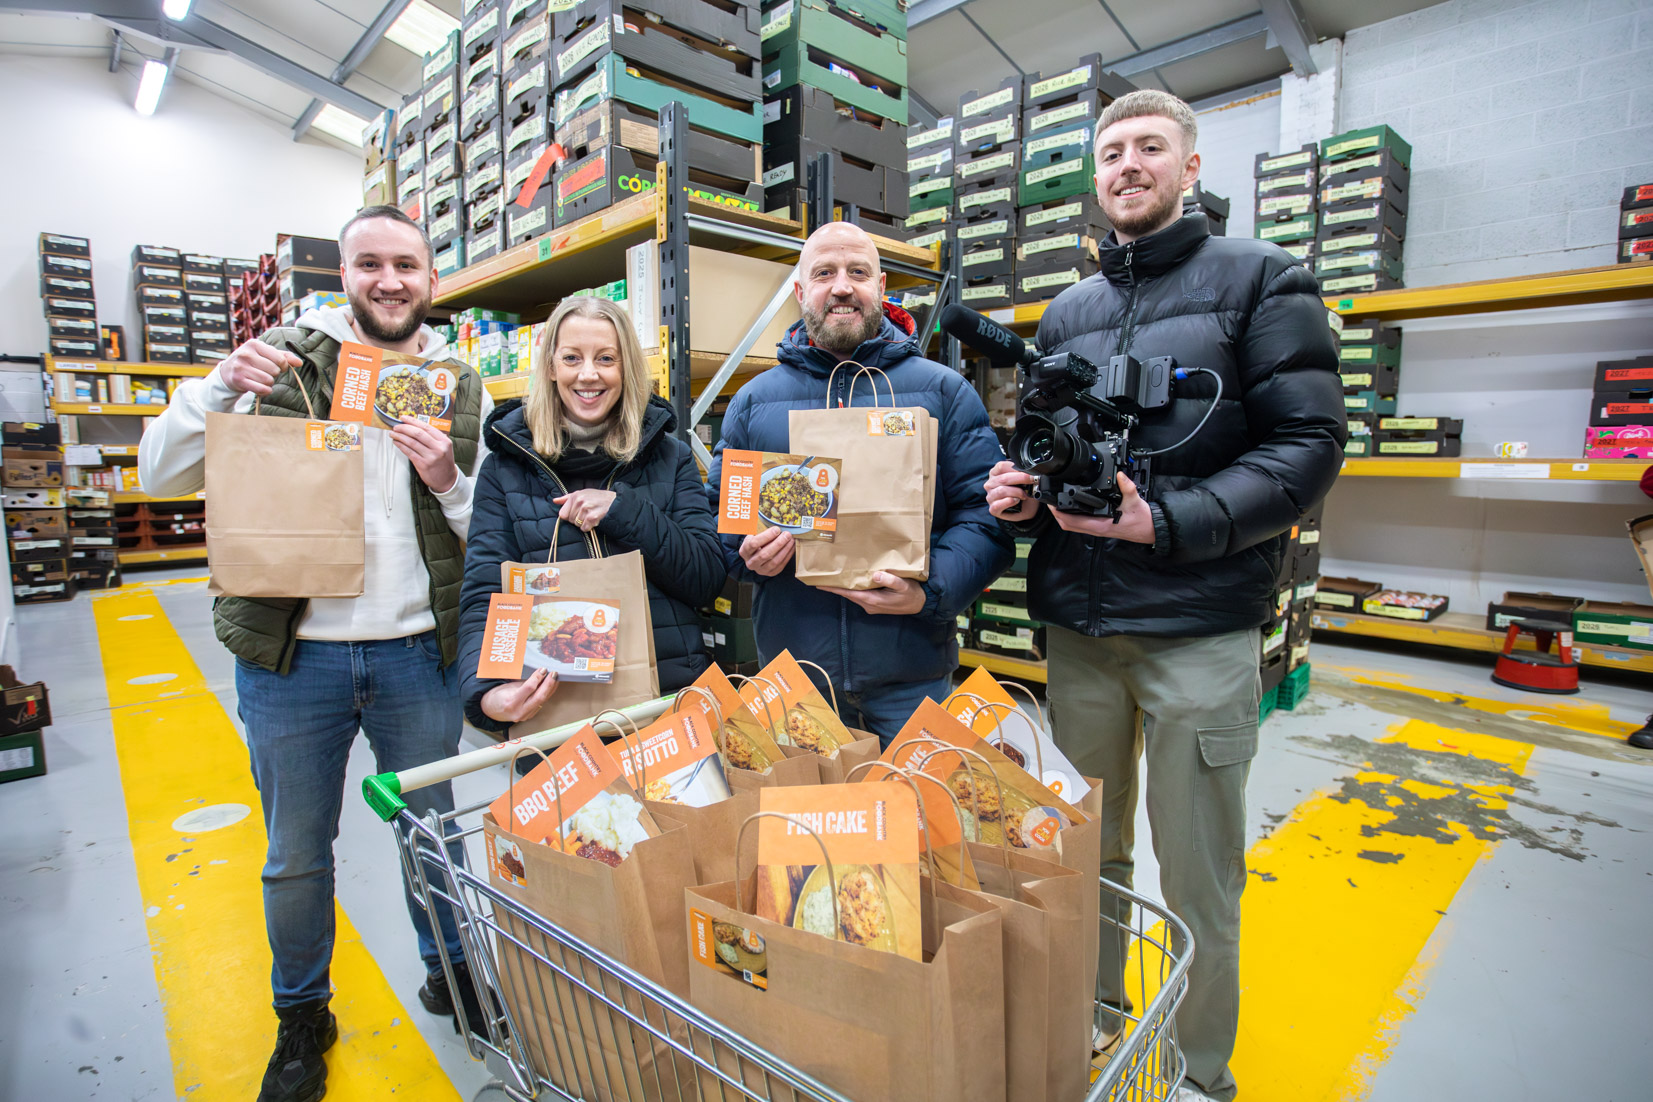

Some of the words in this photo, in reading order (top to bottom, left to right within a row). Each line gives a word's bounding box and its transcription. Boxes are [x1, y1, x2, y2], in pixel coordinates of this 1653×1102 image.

[976, 318, 1012, 348] RØDE
[340, 366, 360, 409] CORNED
[360, 369, 371, 391] HASH
[355, 390, 367, 411] BEEF
[726, 475, 742, 519] CORNED
[742, 476, 753, 498] HASH
[740, 499, 751, 520] BEEF
[490, 618, 510, 662] SAUSAGE
[502, 619, 520, 663] CASSEROLE
[642, 728, 674, 749] SWEETCORN
[684, 717, 697, 749] FOODBANK
[576, 744, 599, 777] FOODBANK
[513, 790, 550, 826] BBQ
[541, 760, 579, 802] BEEF
[787, 812, 822, 835] FISH
[826, 810, 867, 834] CAKE
[1036, 828, 1050, 840] CAN
